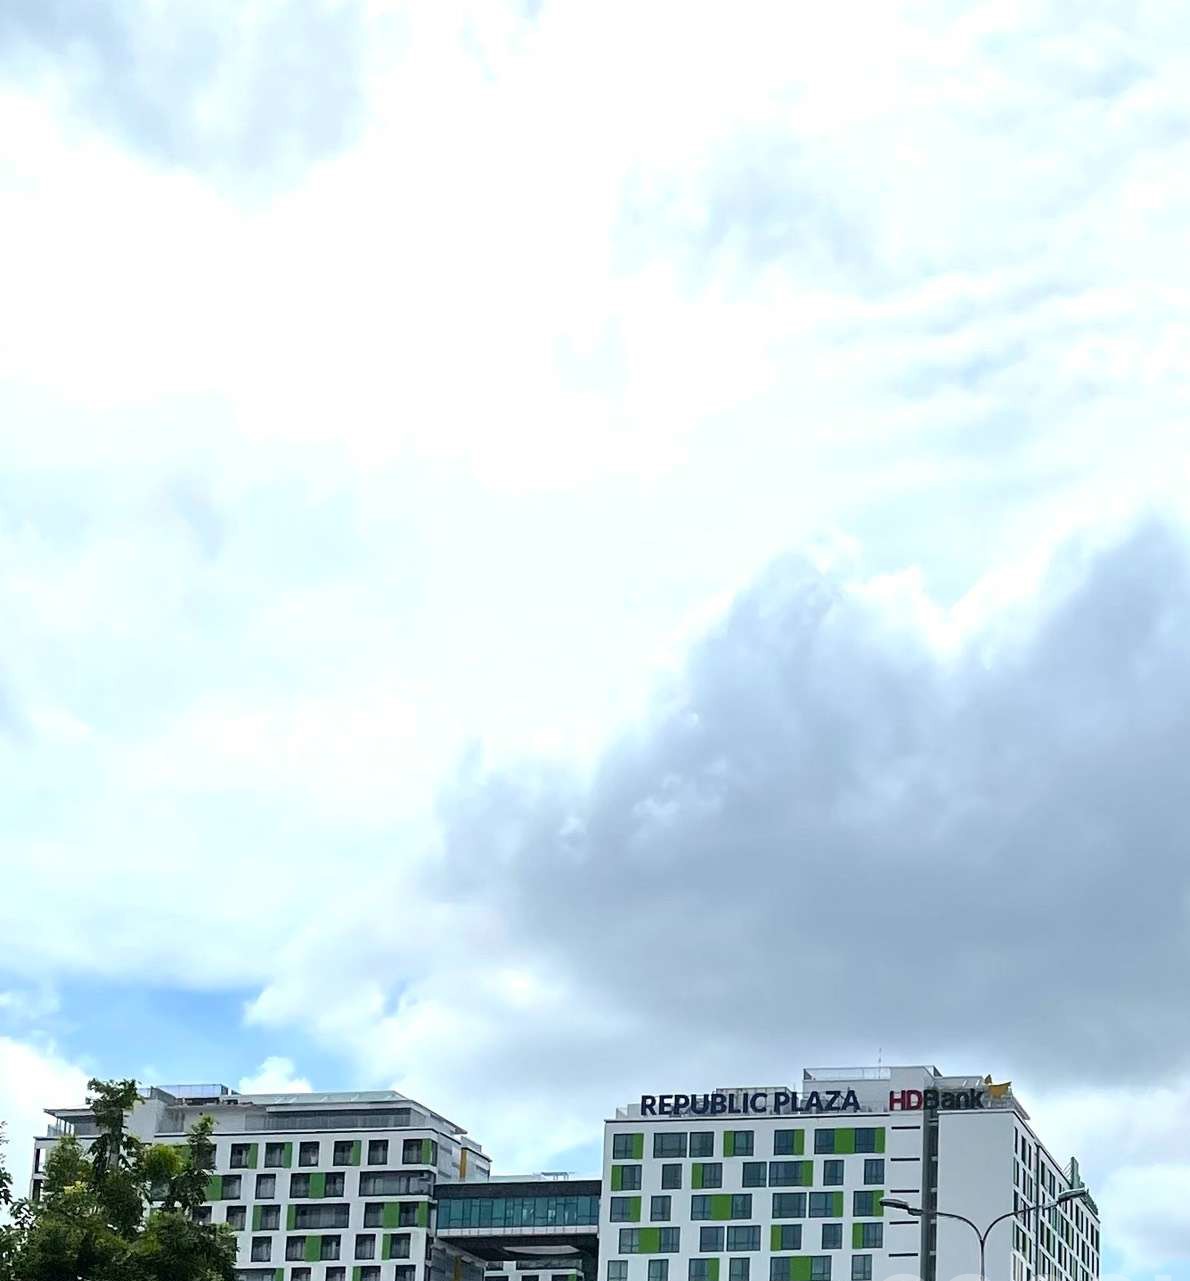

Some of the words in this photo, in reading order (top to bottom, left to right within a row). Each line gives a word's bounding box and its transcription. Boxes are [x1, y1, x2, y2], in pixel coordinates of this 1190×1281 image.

[640, 1090, 768, 1117] REPUBLIC
[773, 1088, 861, 1113] PLAZA
[889, 1088, 985, 1111] HDBank
